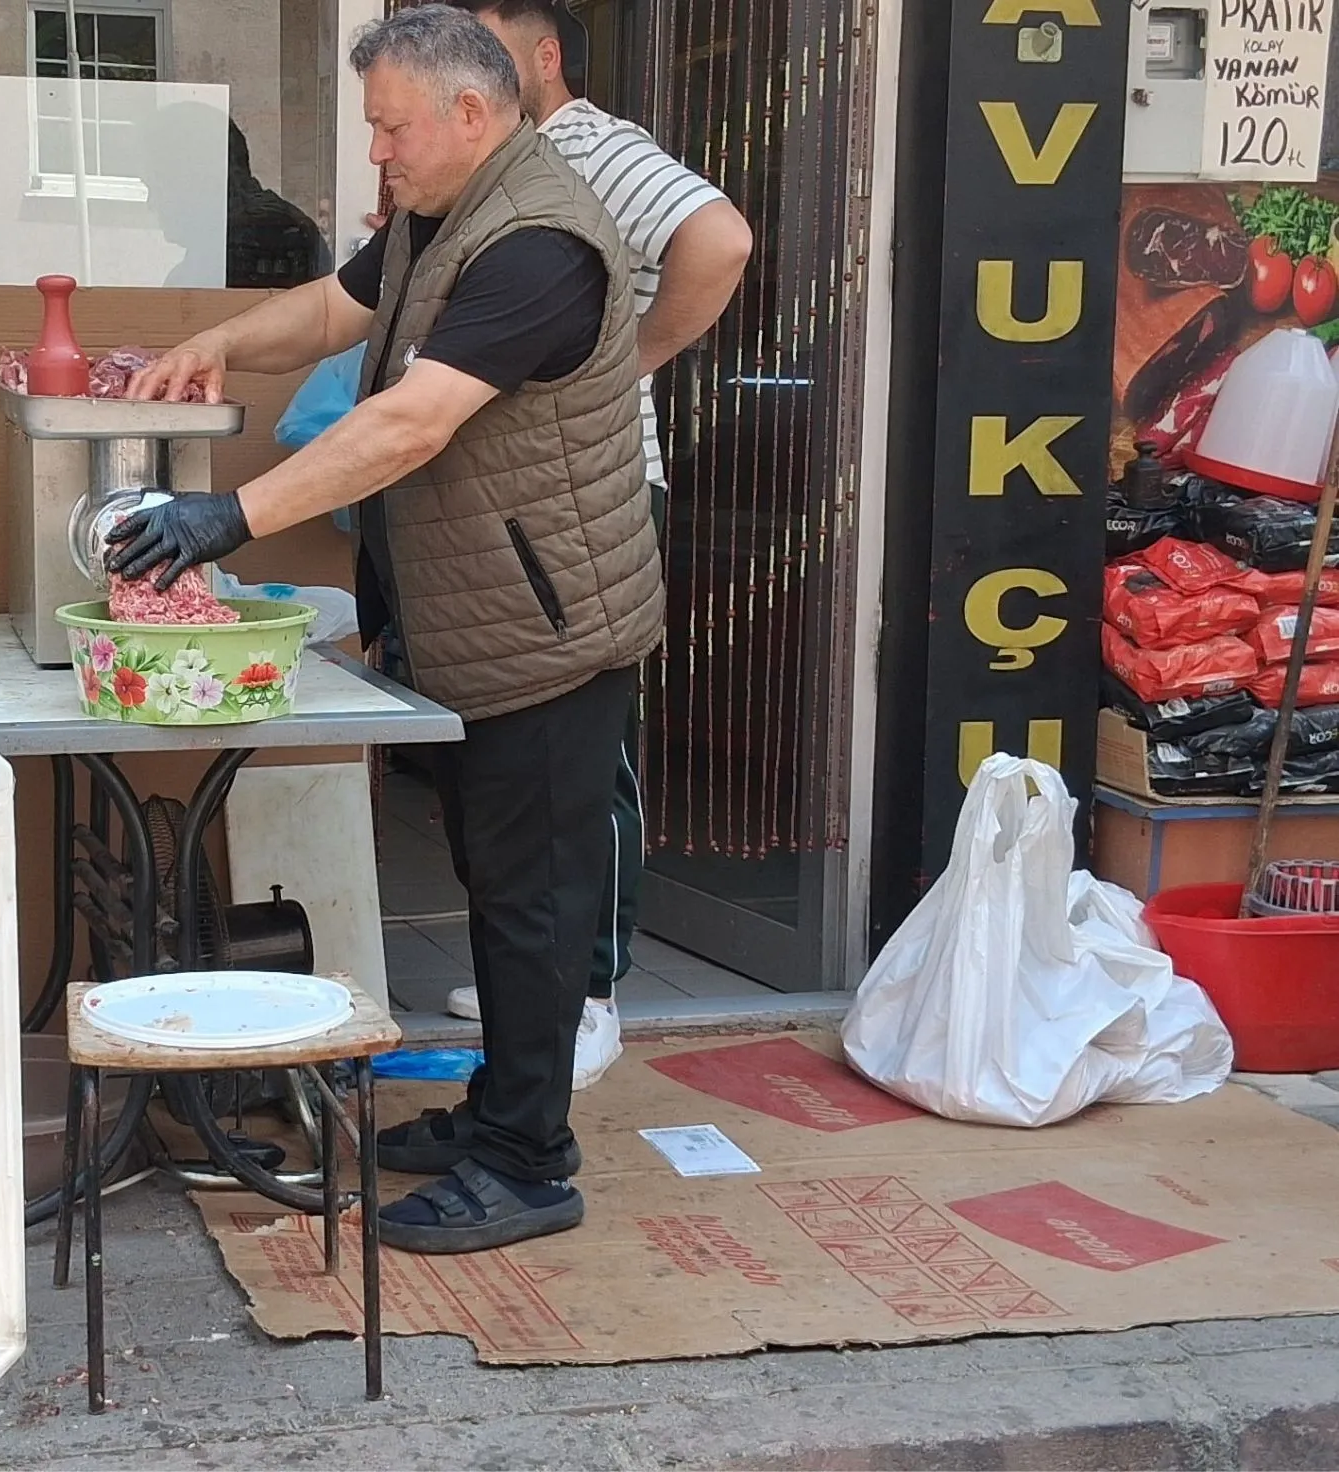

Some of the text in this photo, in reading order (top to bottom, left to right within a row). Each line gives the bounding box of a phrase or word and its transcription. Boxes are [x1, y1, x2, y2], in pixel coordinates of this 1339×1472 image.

[1213, 56, 1299, 81] YANAN
[1243, 38, 1284, 54] KOLAY
[958, 0, 1102, 799] VUKÇU
[763, 1073, 860, 1126] arçelik
[684, 1214, 784, 1287] buzdolabı
[1045, 1217, 1138, 1266] arçelik
